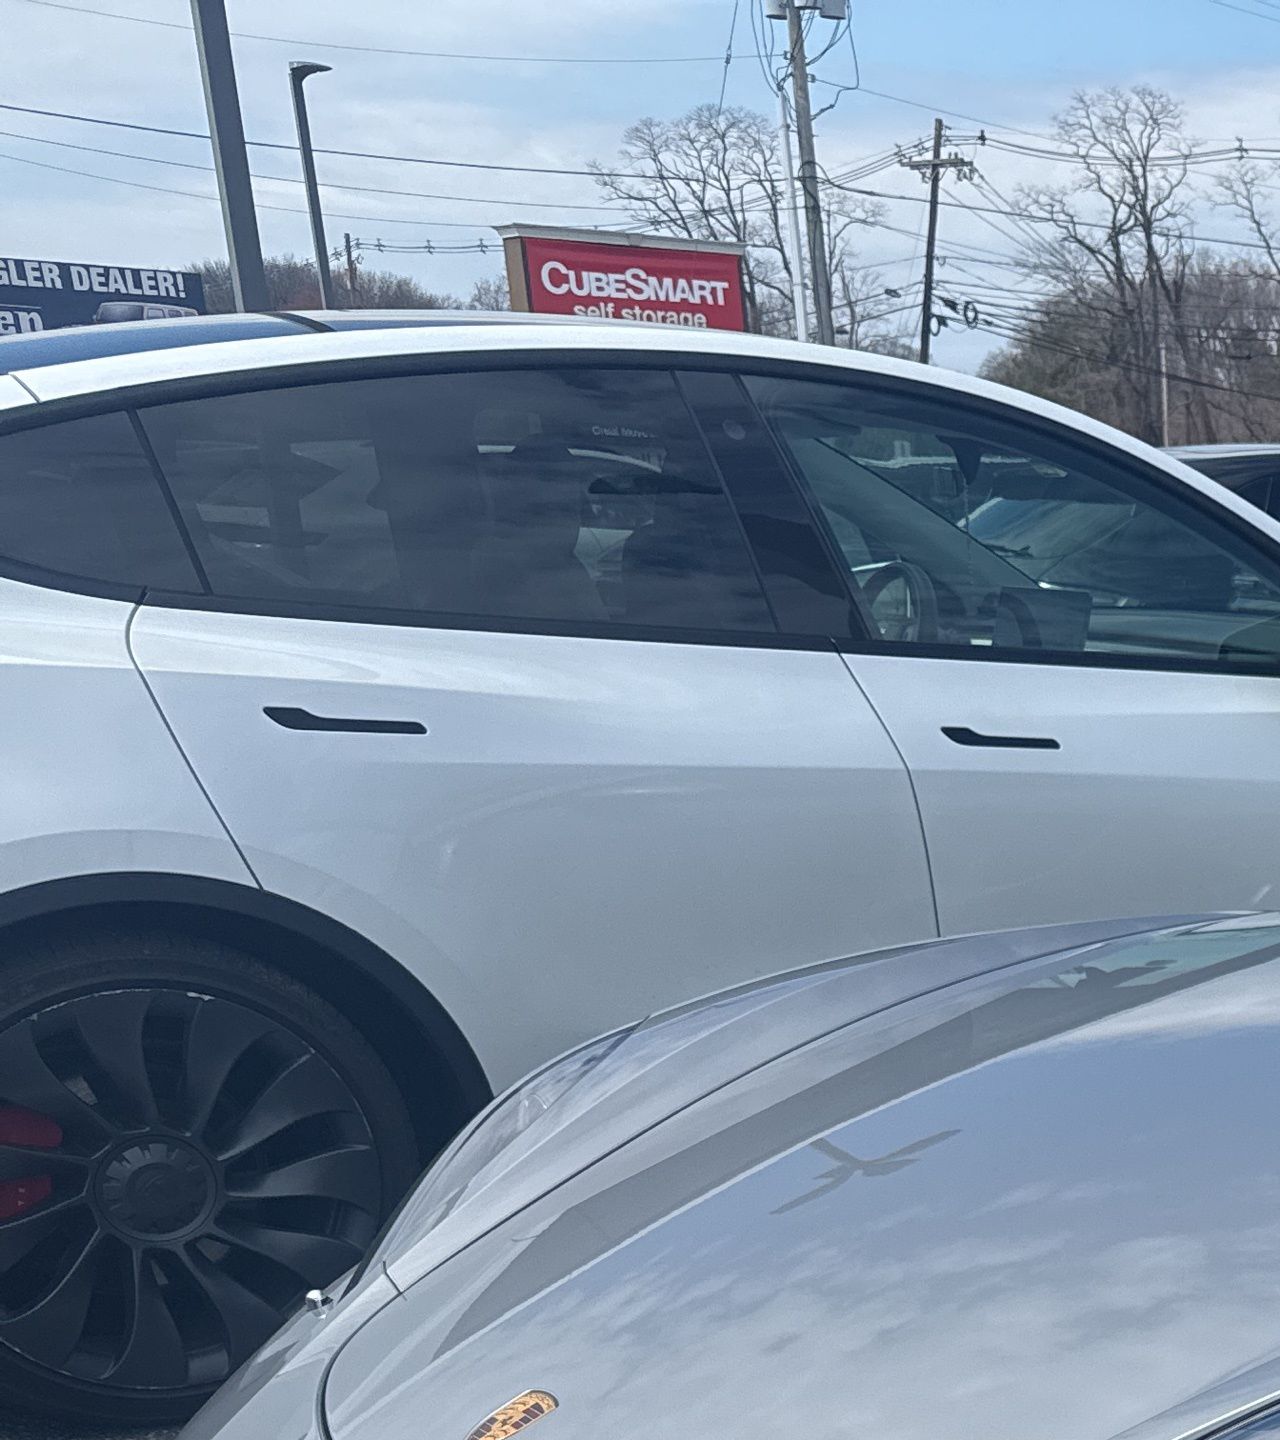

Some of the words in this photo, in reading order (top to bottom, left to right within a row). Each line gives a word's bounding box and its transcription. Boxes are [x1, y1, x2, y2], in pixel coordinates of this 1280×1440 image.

[69, 264, 187, 299] DEALER!
[573, 302, 615, 319] self
[621, 305, 708, 328] storage
